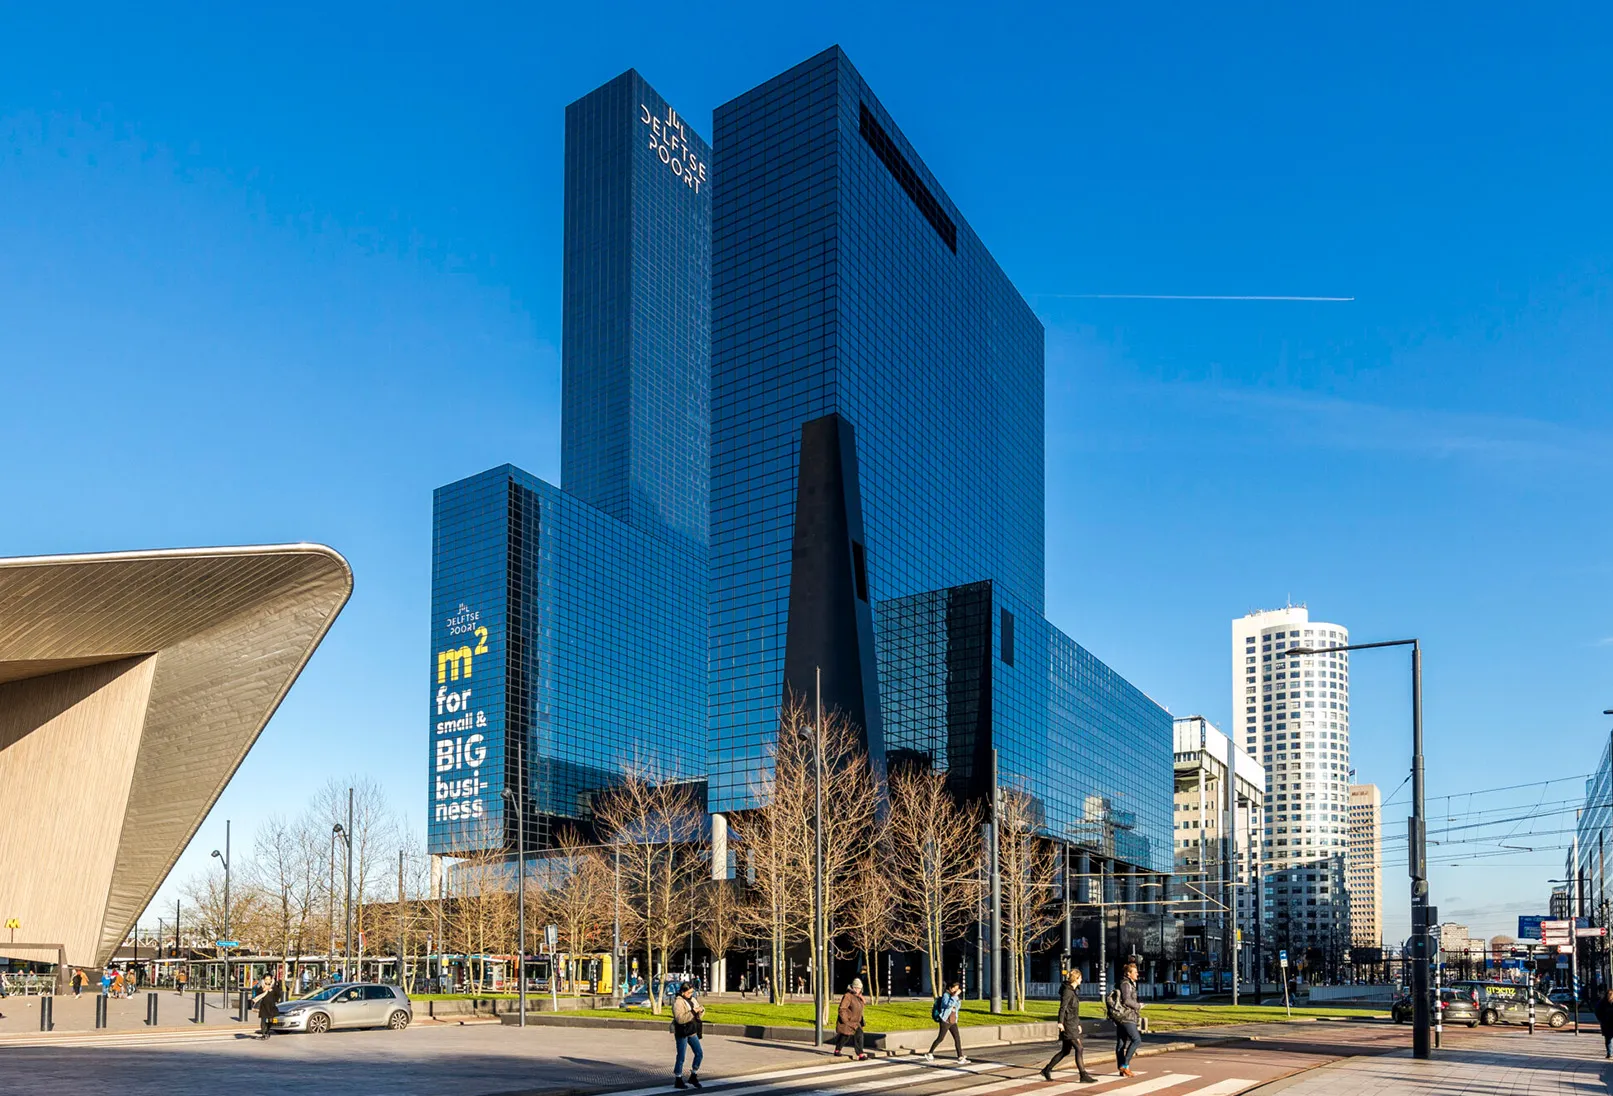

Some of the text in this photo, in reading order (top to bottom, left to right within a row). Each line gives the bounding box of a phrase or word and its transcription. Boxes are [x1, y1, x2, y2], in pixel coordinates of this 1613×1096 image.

[641, 104, 706, 182] DELFTSE
[649, 133, 700, 194] POORT
[446, 611, 480, 628] DELFTSE
[450, 622, 476, 636] POORT
[436, 685, 472, 715] for
[437, 710, 487, 735] small &
[437, 733, 487, 772] BIG
[436, 769, 488, 801] busi-
[435, 799, 483, 822] ness
